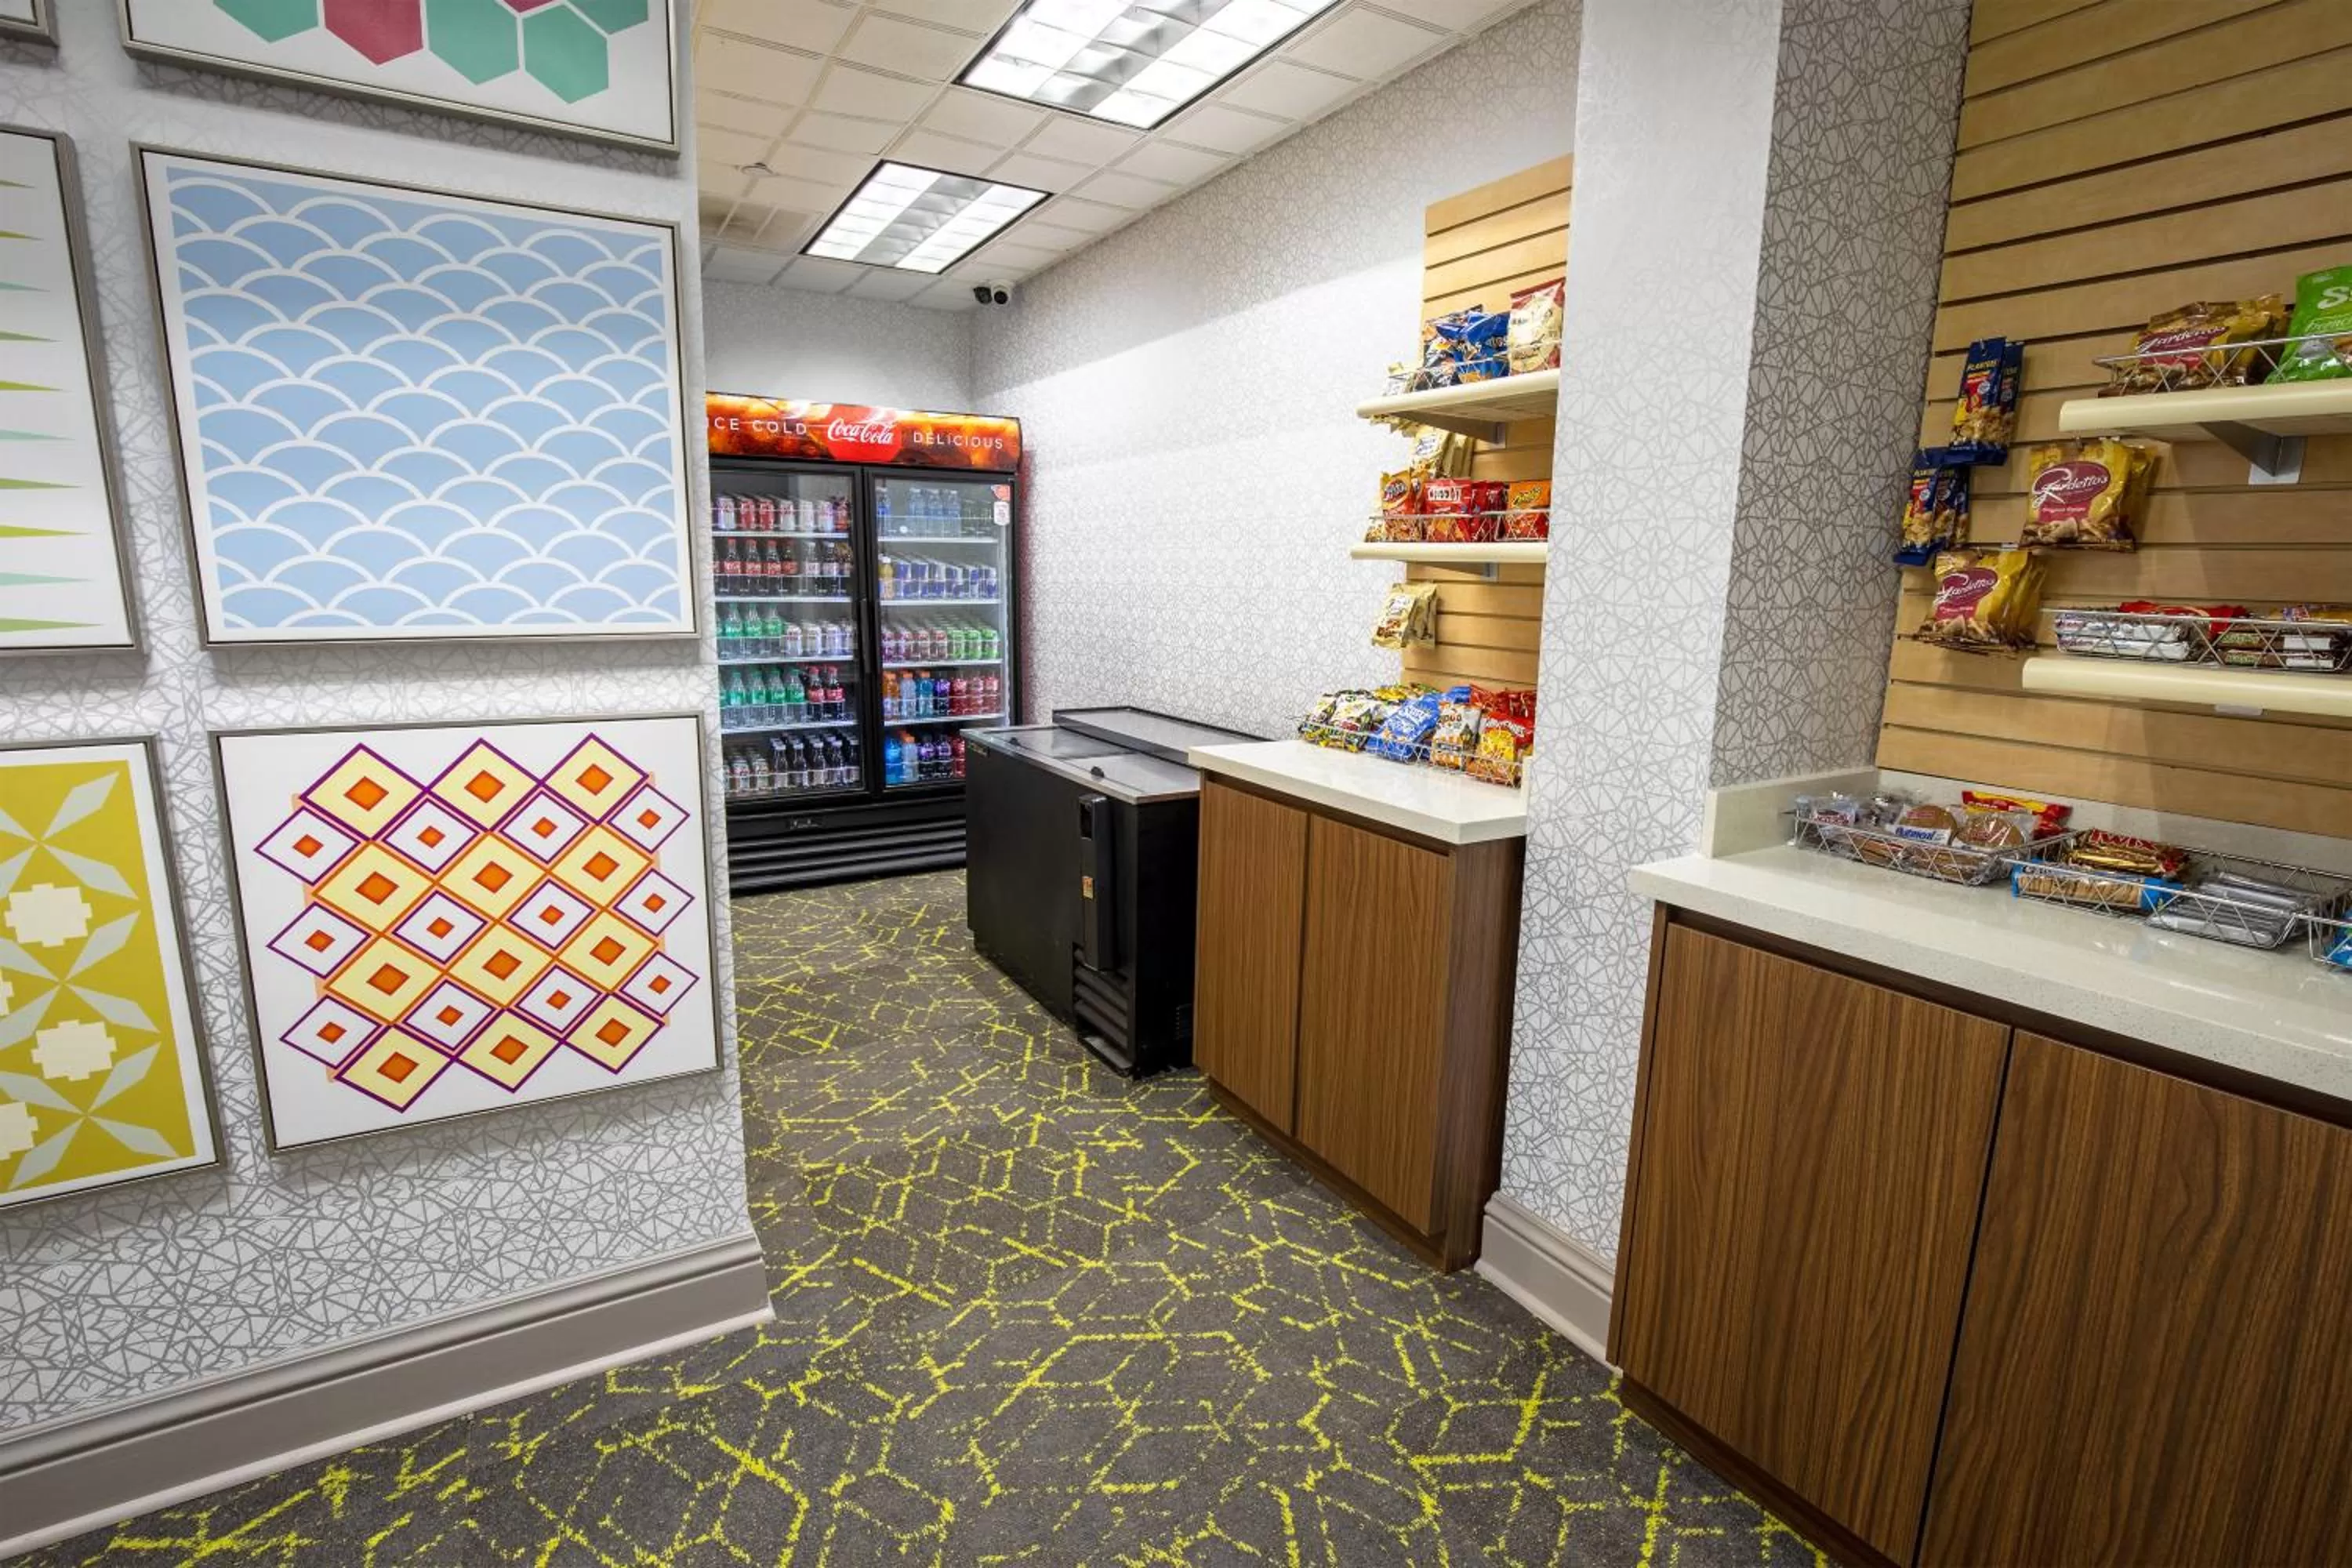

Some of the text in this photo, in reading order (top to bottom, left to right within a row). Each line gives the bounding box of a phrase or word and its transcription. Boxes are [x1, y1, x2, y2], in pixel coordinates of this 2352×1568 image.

[752, 419, 807, 435] COLD
[827, 418, 894, 445] Coca-Cola
[913, 430, 1004, 449] DELICIOUS
[1895, 826, 1936, 840] Oatmeal
[2088, 828, 2158, 851] TWIX
